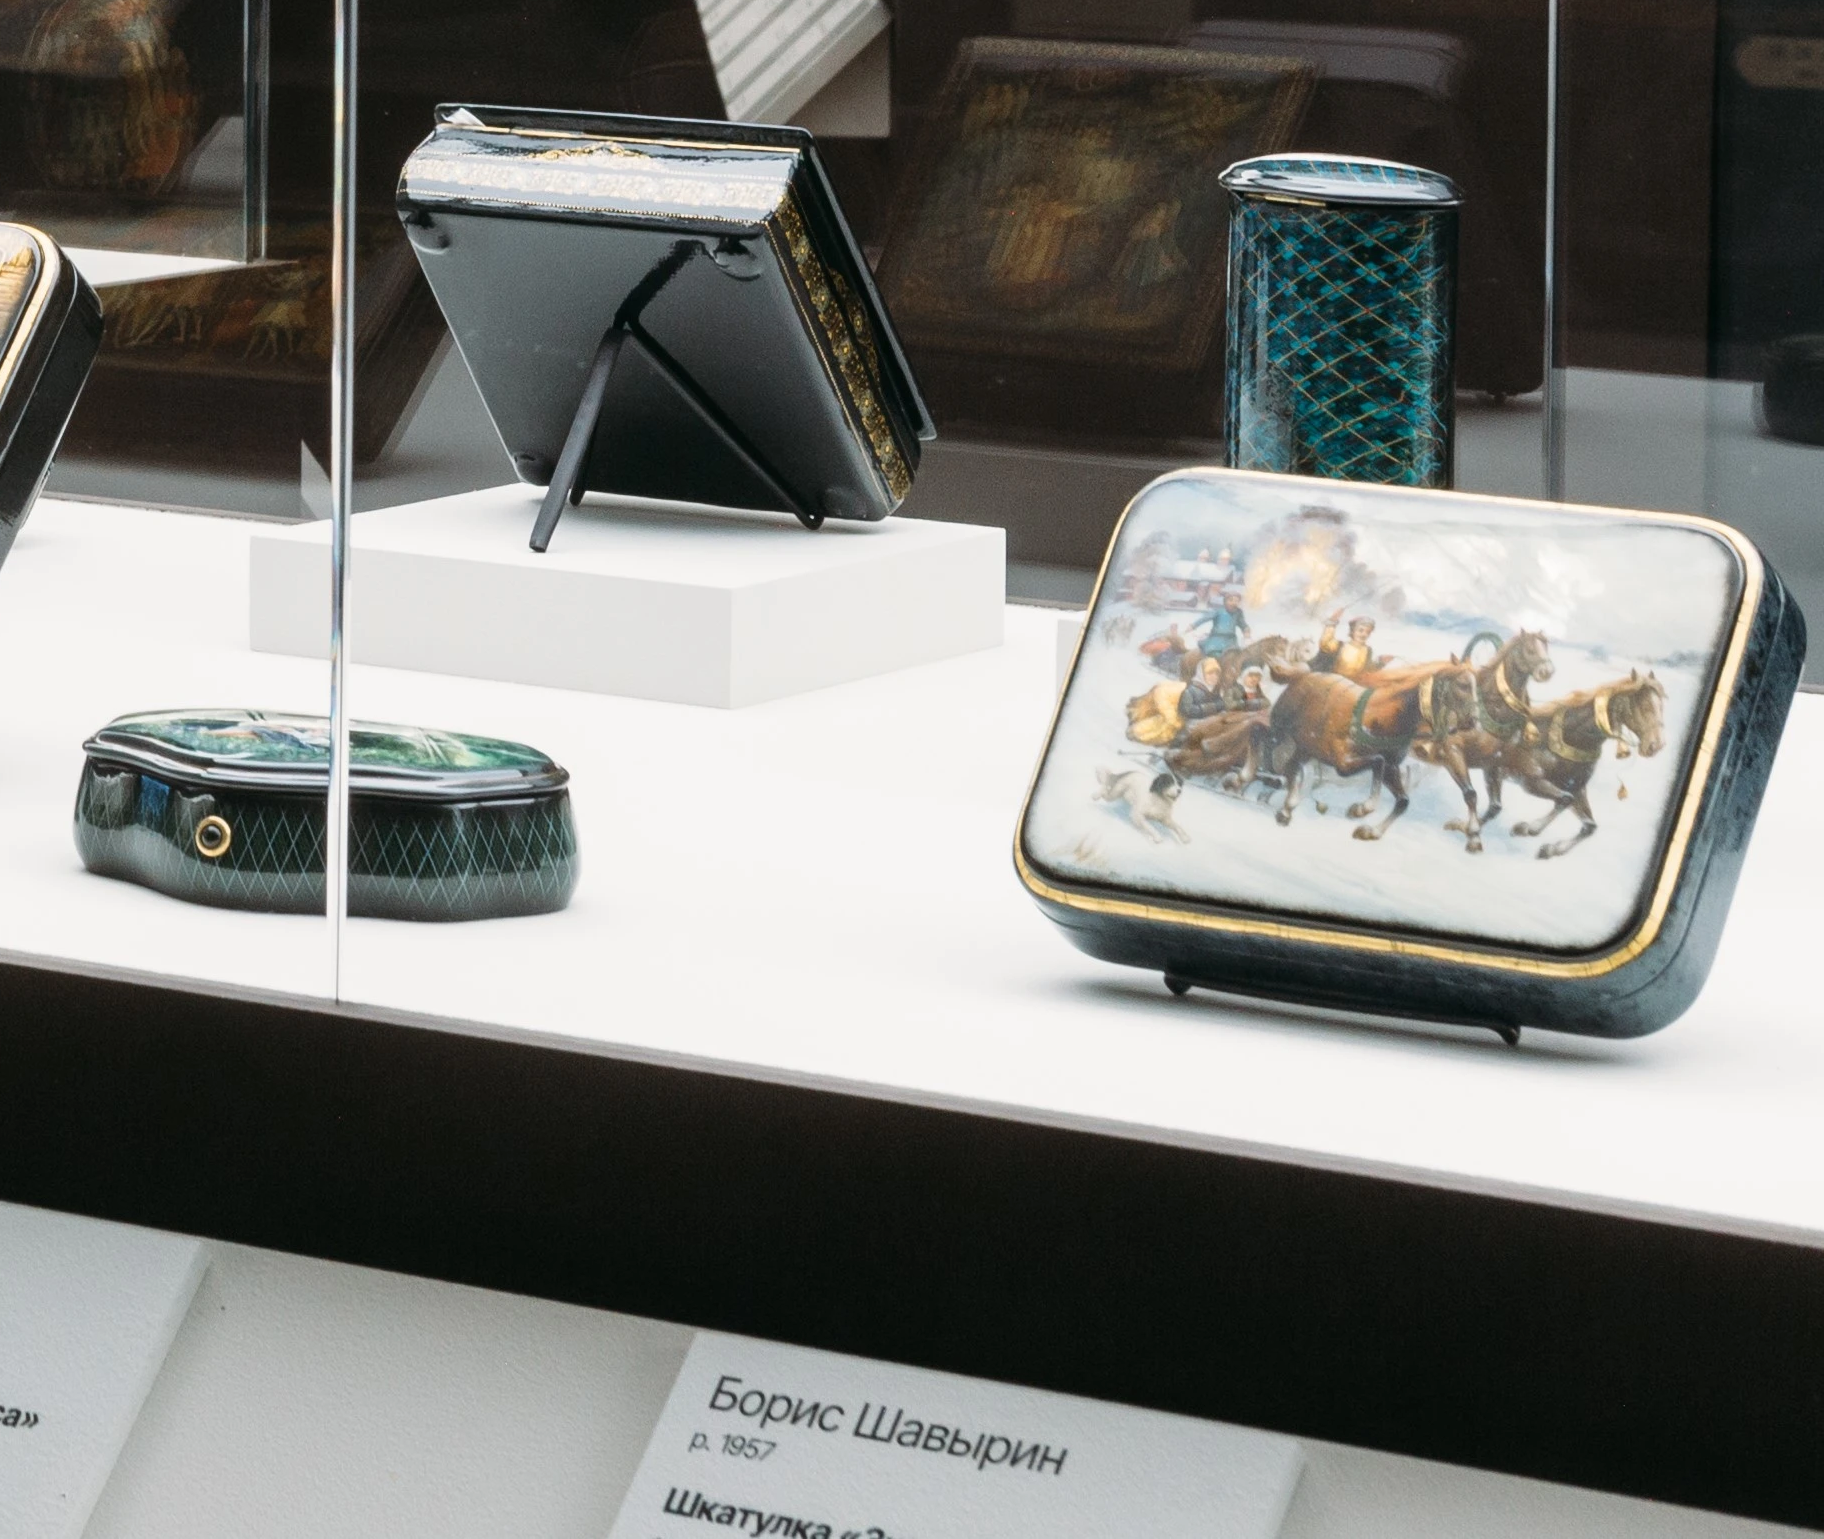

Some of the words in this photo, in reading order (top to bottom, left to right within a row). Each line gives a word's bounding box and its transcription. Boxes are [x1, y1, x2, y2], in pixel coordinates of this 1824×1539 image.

[687, 1431, 710, 1453] р.
[721, 1433, 778, 1462] 1957
[708, 1375, 846, 1433] Борис
[852, 1402, 1068, 1476] Шавырин
[662, 1487, 833, 1539] Шкатулка
